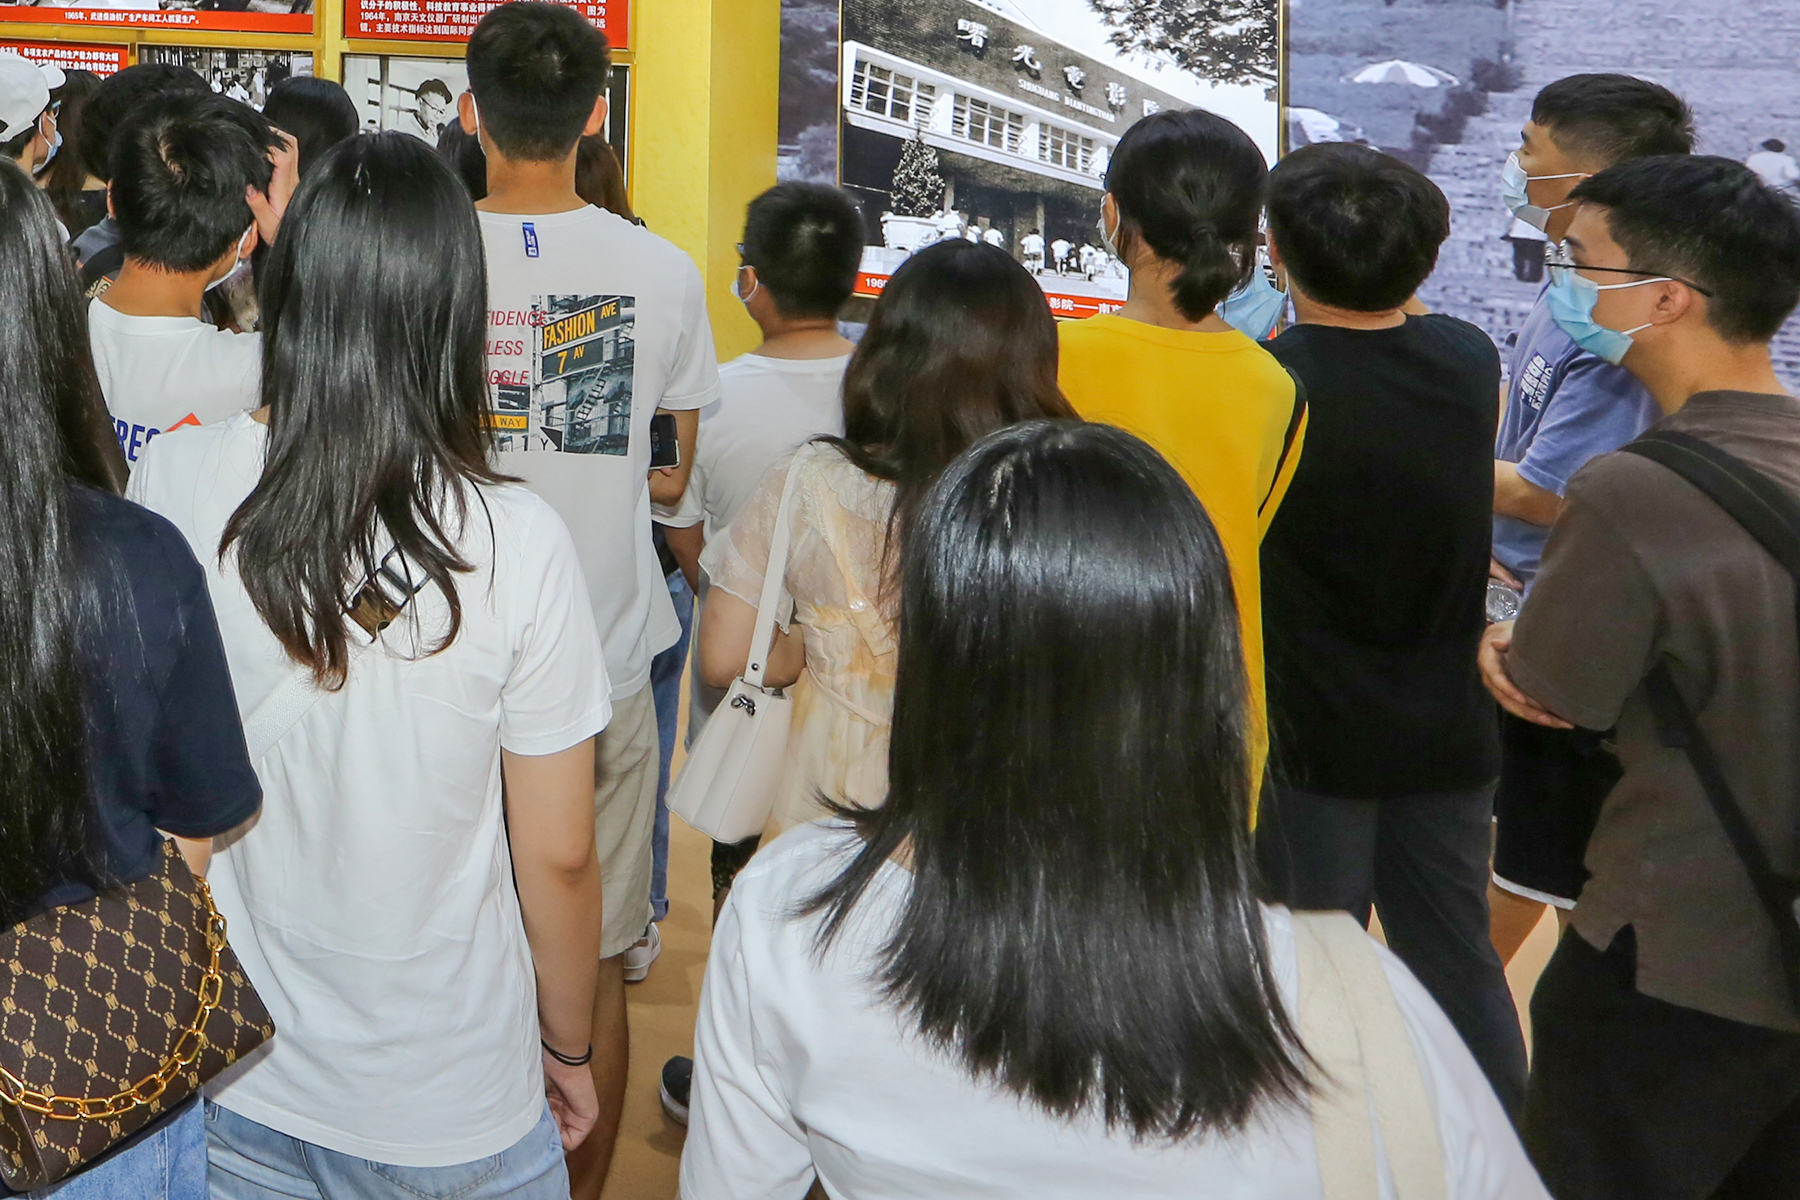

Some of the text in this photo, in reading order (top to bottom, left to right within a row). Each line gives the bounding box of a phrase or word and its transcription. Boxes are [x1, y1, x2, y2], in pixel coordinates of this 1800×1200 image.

[360, 0, 503, 13] 识分子的积极性，科技教育事业得到
[543, 302, 617, 349] FASHION AVE
[557, 345, 585, 375] 7 AV
[488, 369, 529, 386] GGLE
